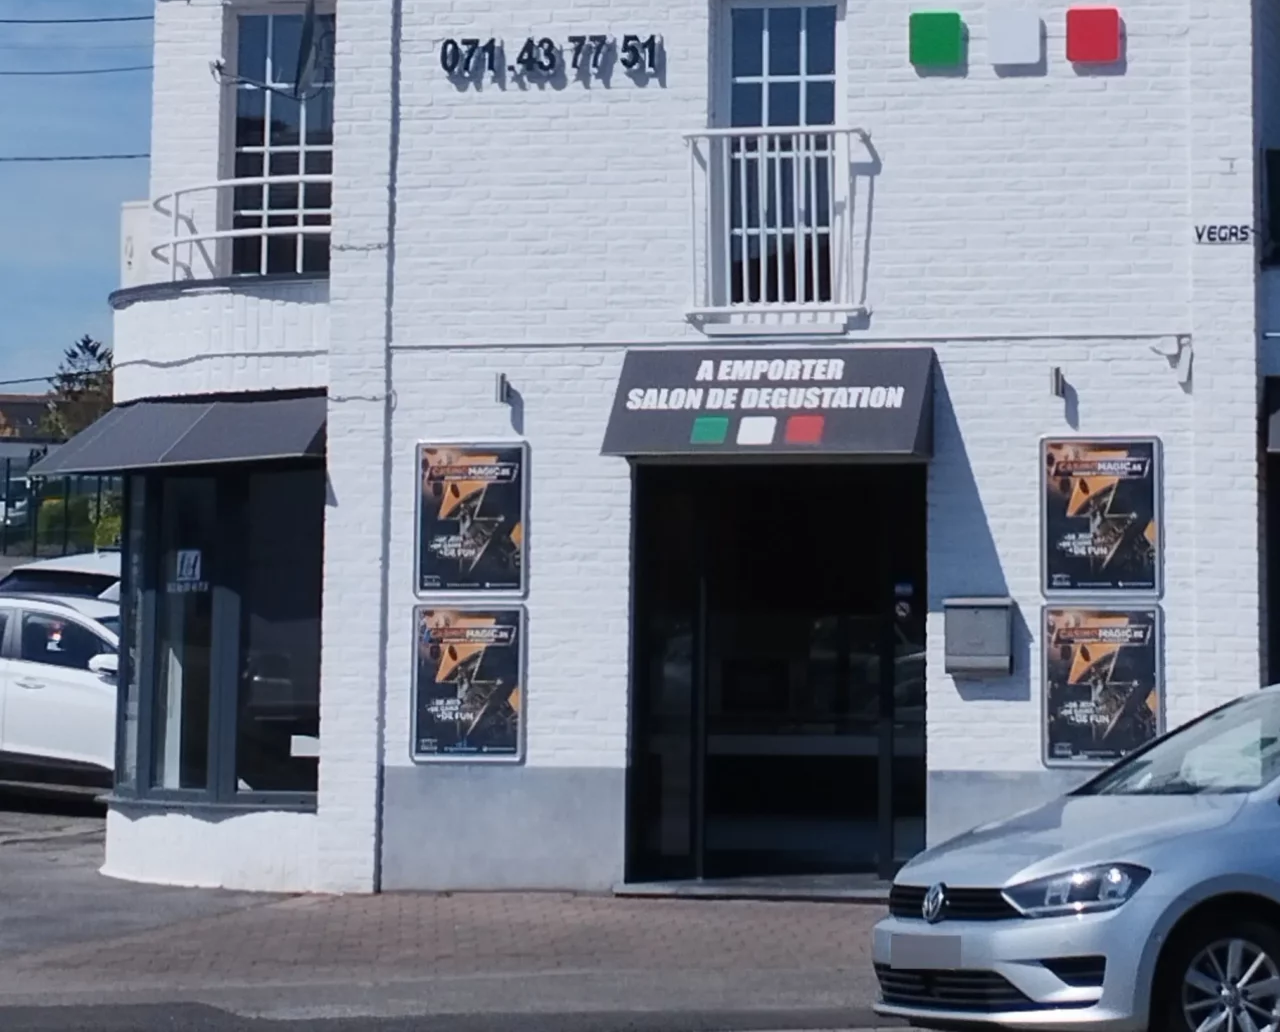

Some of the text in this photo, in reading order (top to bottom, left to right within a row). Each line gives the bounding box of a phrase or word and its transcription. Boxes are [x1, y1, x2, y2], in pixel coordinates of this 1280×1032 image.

[568, 35, 607, 68] 77
[621, 34, 657, 68] 51
[1194, 225, 1250, 243] VEGAS
[695, 358, 845, 382] A EMPORTER
[626, 386, 904, 410] SALON DE DEGUSTATION
